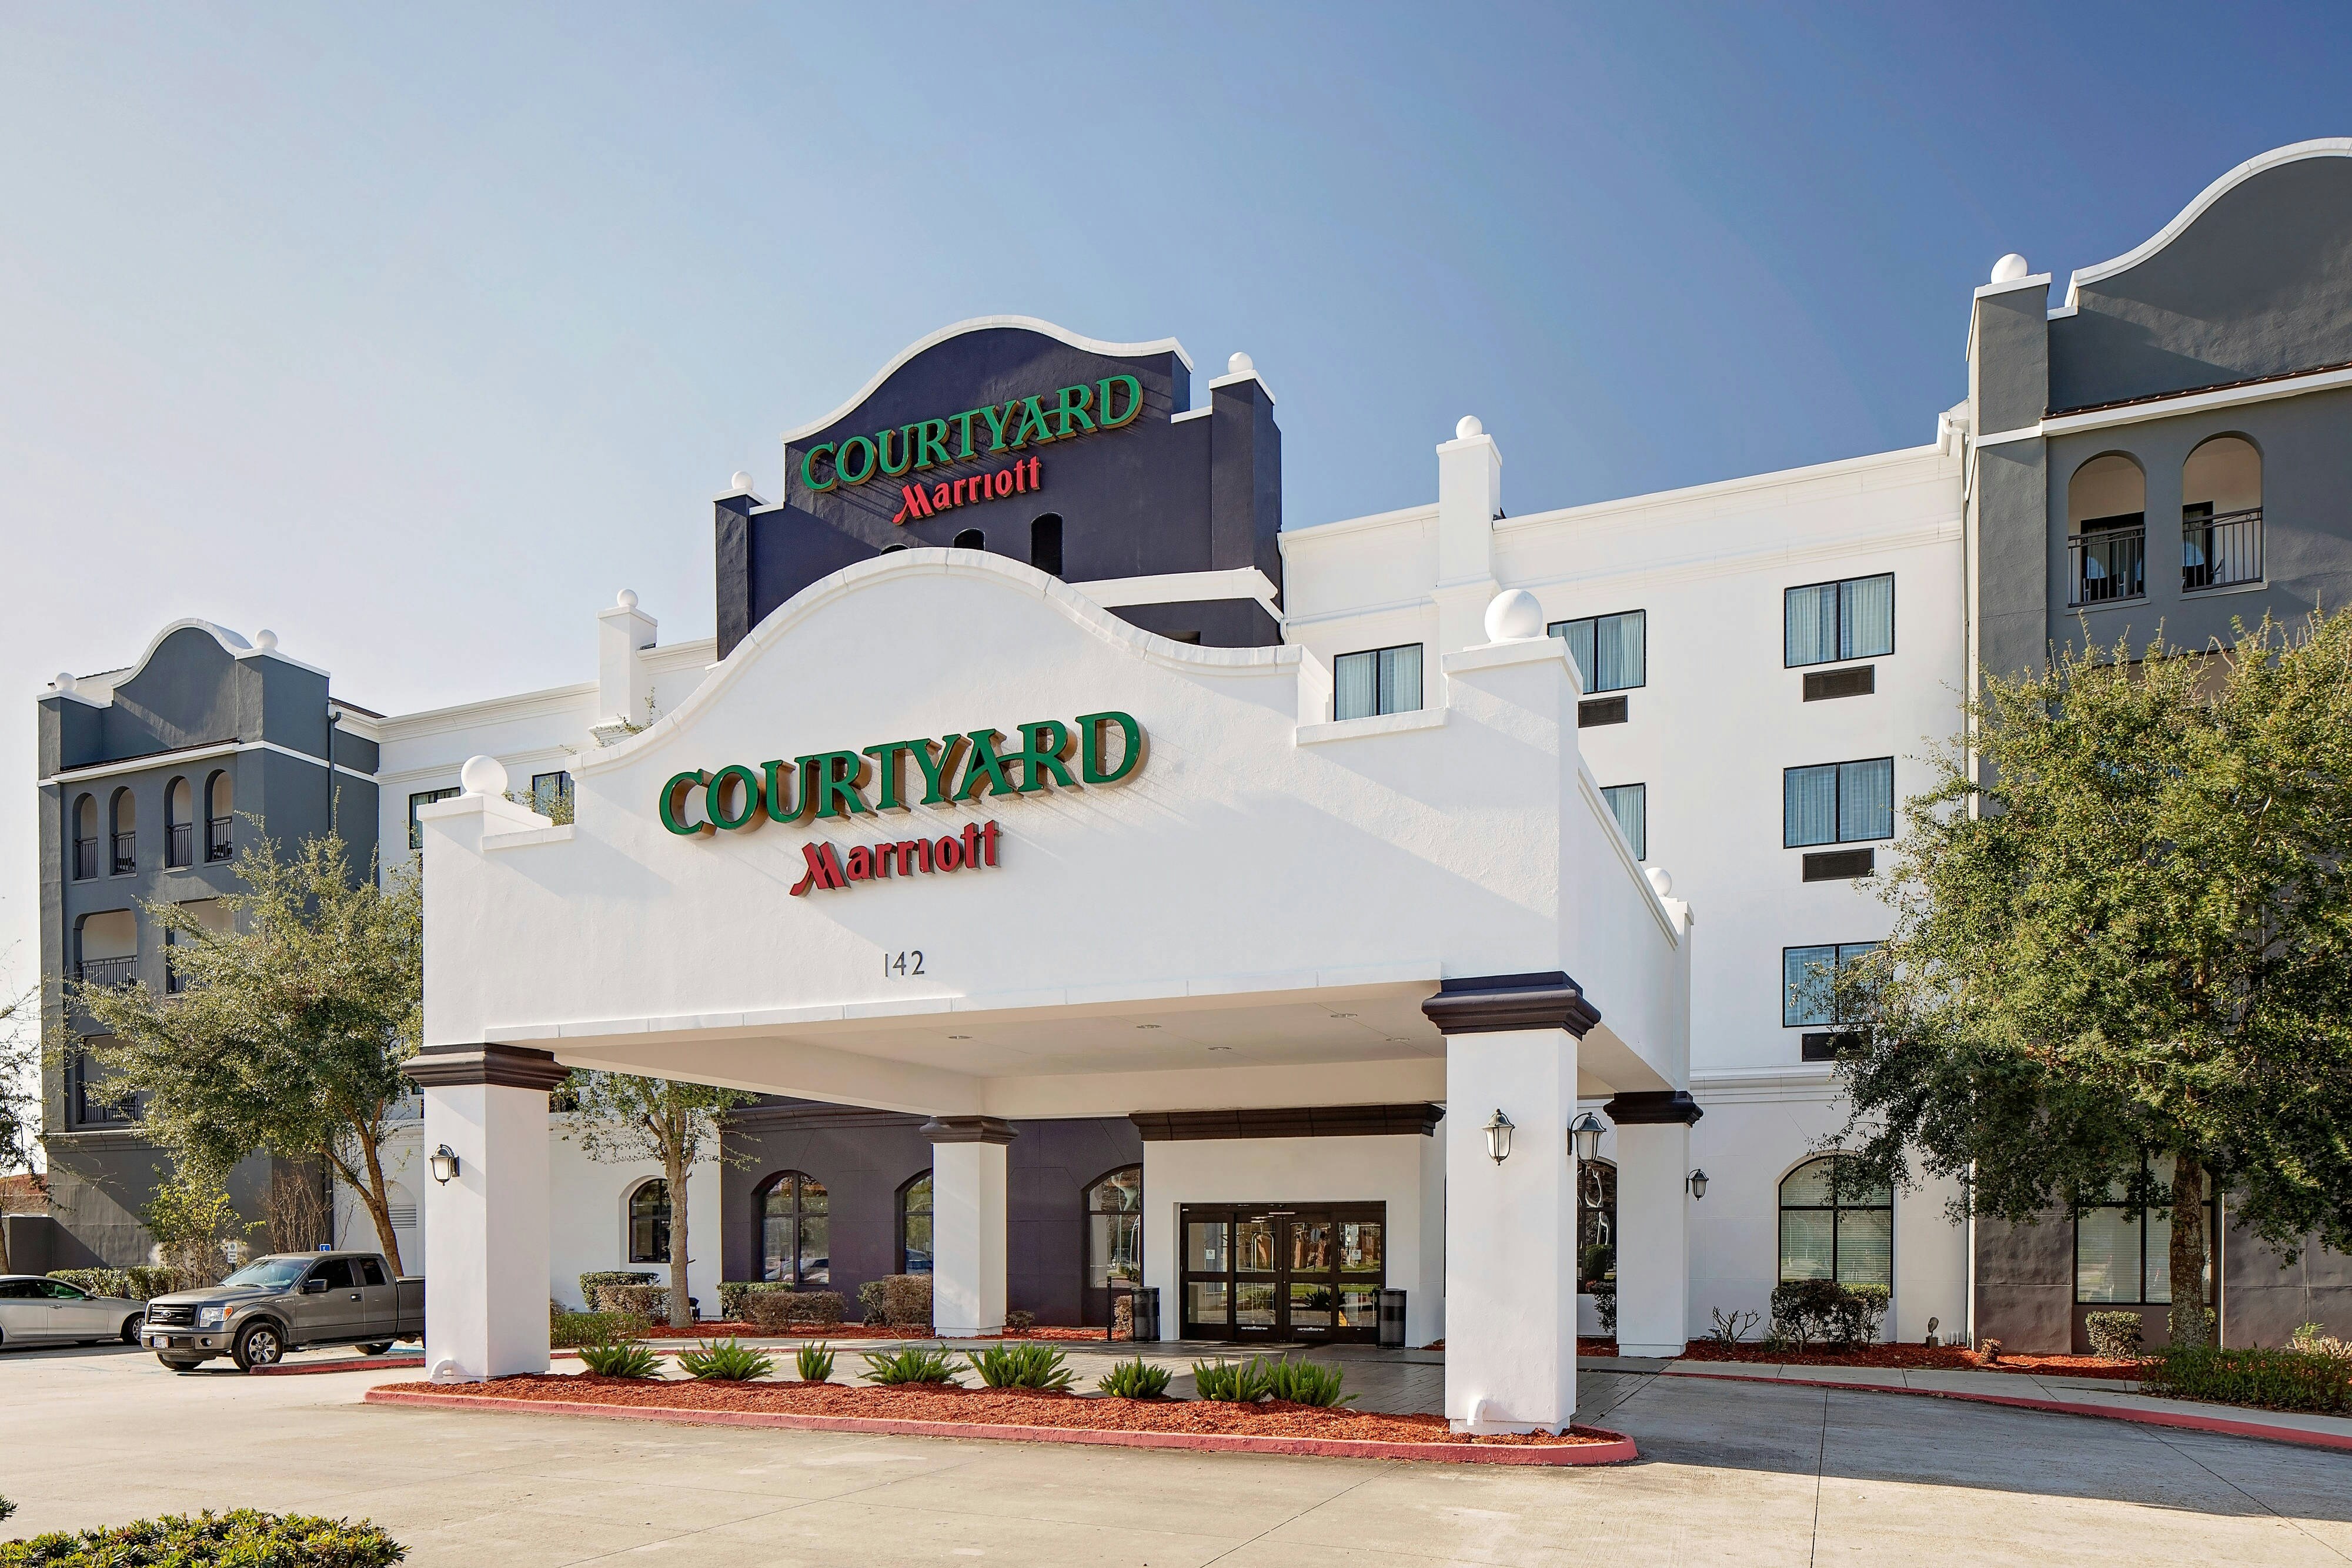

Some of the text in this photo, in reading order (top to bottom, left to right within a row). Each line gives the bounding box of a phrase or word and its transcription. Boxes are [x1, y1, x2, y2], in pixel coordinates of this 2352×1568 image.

[801, 375, 1143, 492] COURTYARD
[892, 456, 1041, 525] Marriott
[659, 711, 1148, 838] COURTYARD
[790, 820, 1001, 897] Marriott
[884, 951, 925, 977] 142
